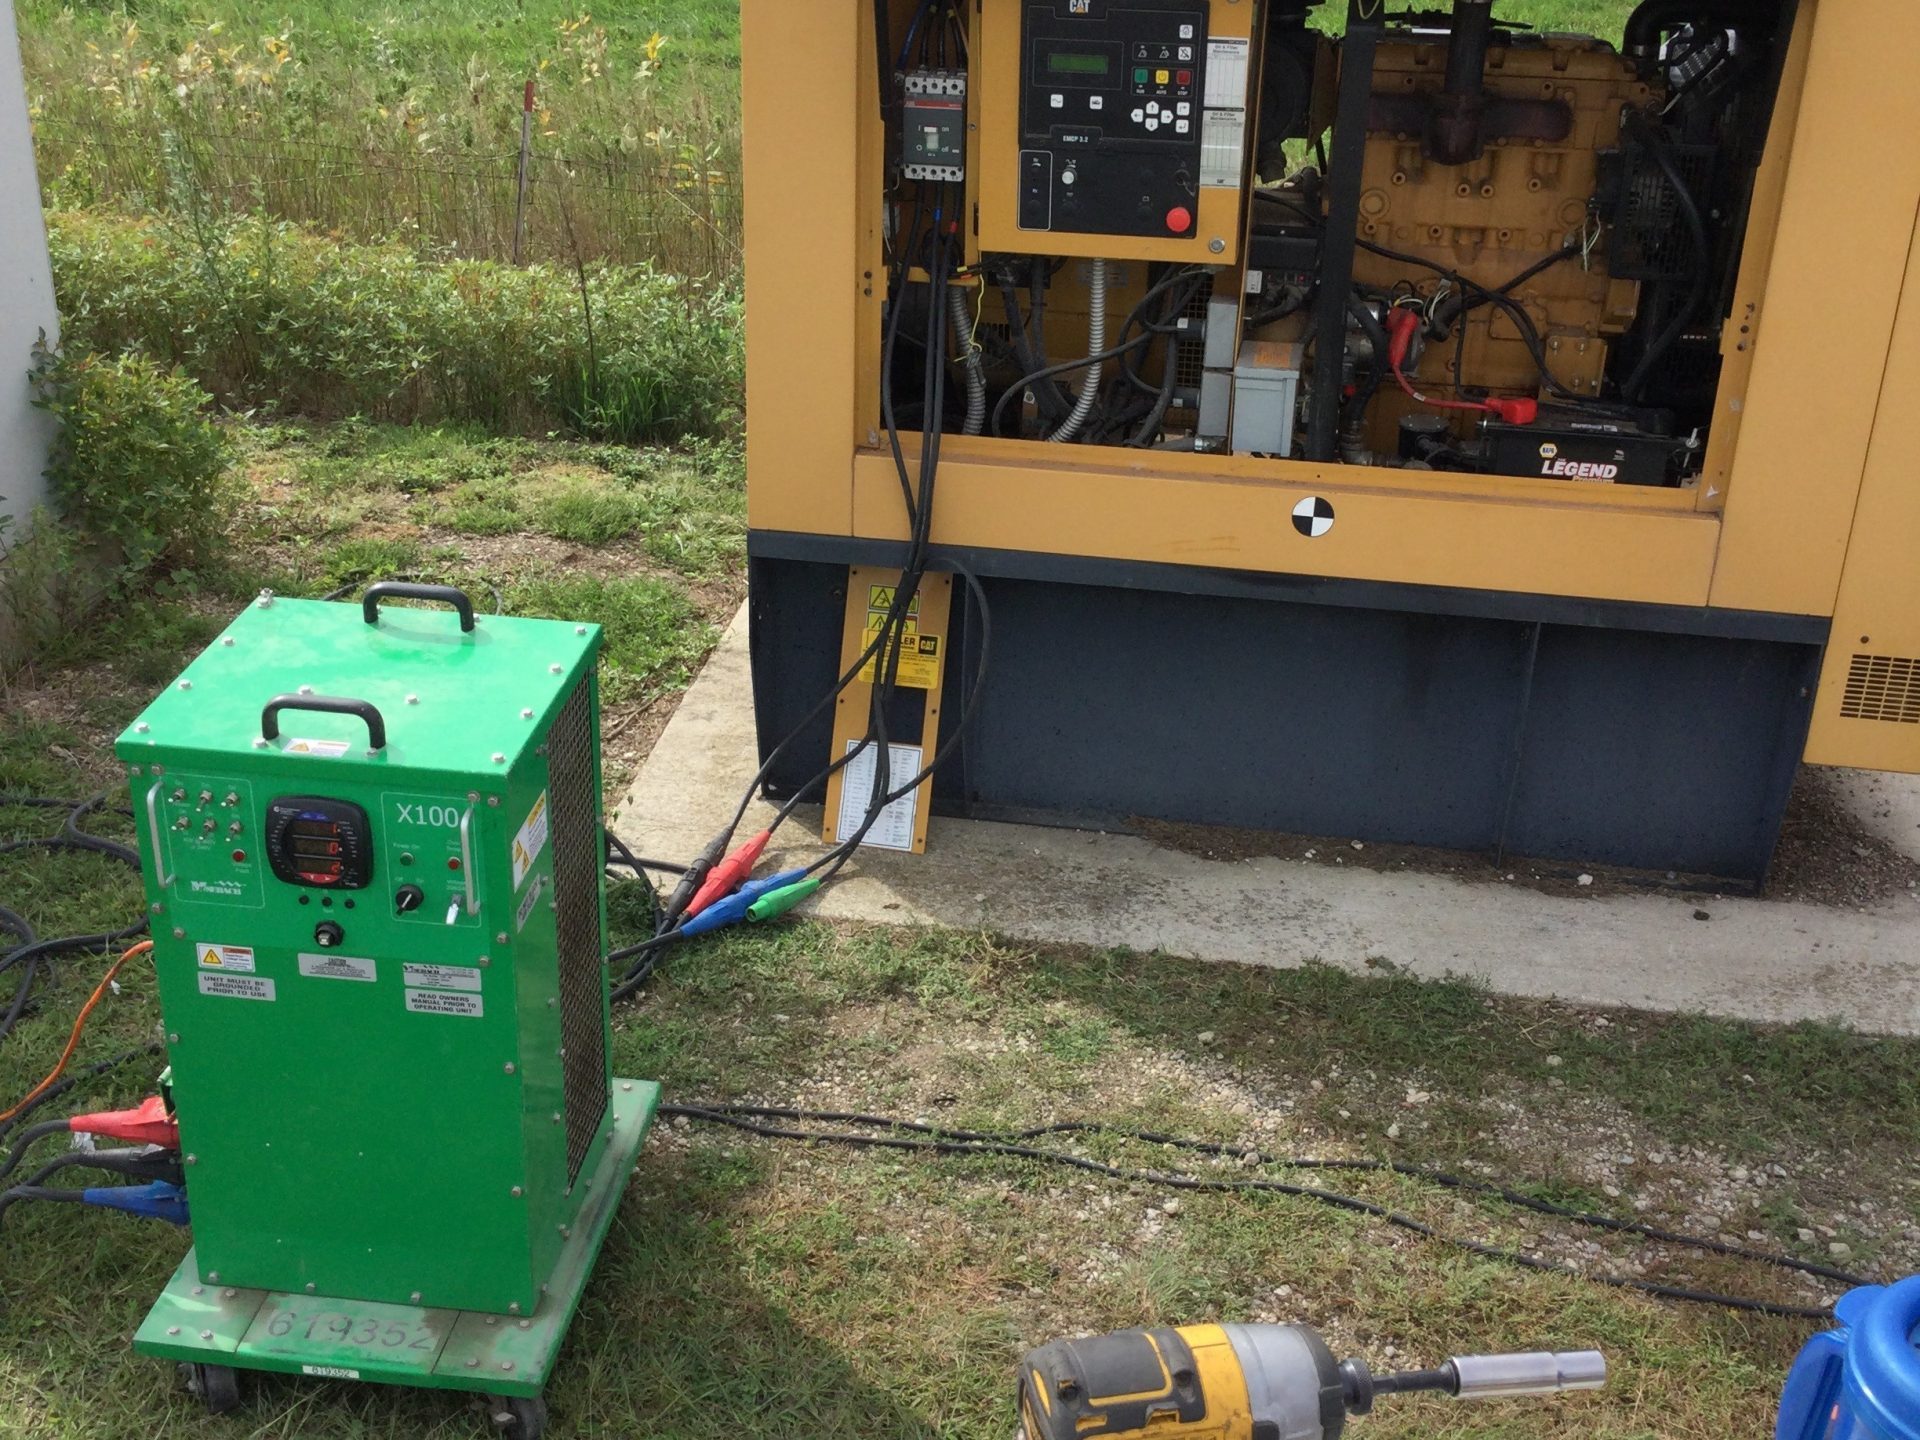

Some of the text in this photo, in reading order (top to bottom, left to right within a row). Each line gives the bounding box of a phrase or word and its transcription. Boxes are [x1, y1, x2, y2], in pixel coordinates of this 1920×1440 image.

[1069, 0, 1090, 13] CAT
[1541, 460, 1618, 478] LEGEND
[919, 640, 936, 651] CAT
[395, 802, 460, 829] X100
[203, 975, 224, 983] UNIT
[227, 978, 251, 986] MUST
[207, 986, 234, 995] PRIOR
[213, 982, 261, 992] GROUNDED
[411, 998, 441, 1006] MANUAL
[443, 1000, 466, 1008] PRIOR
[417, 992, 470, 1003] READ OWNERS
[413, 1003, 454, 1013] OPERATING
[268, 1312, 431, 1349] 619352
